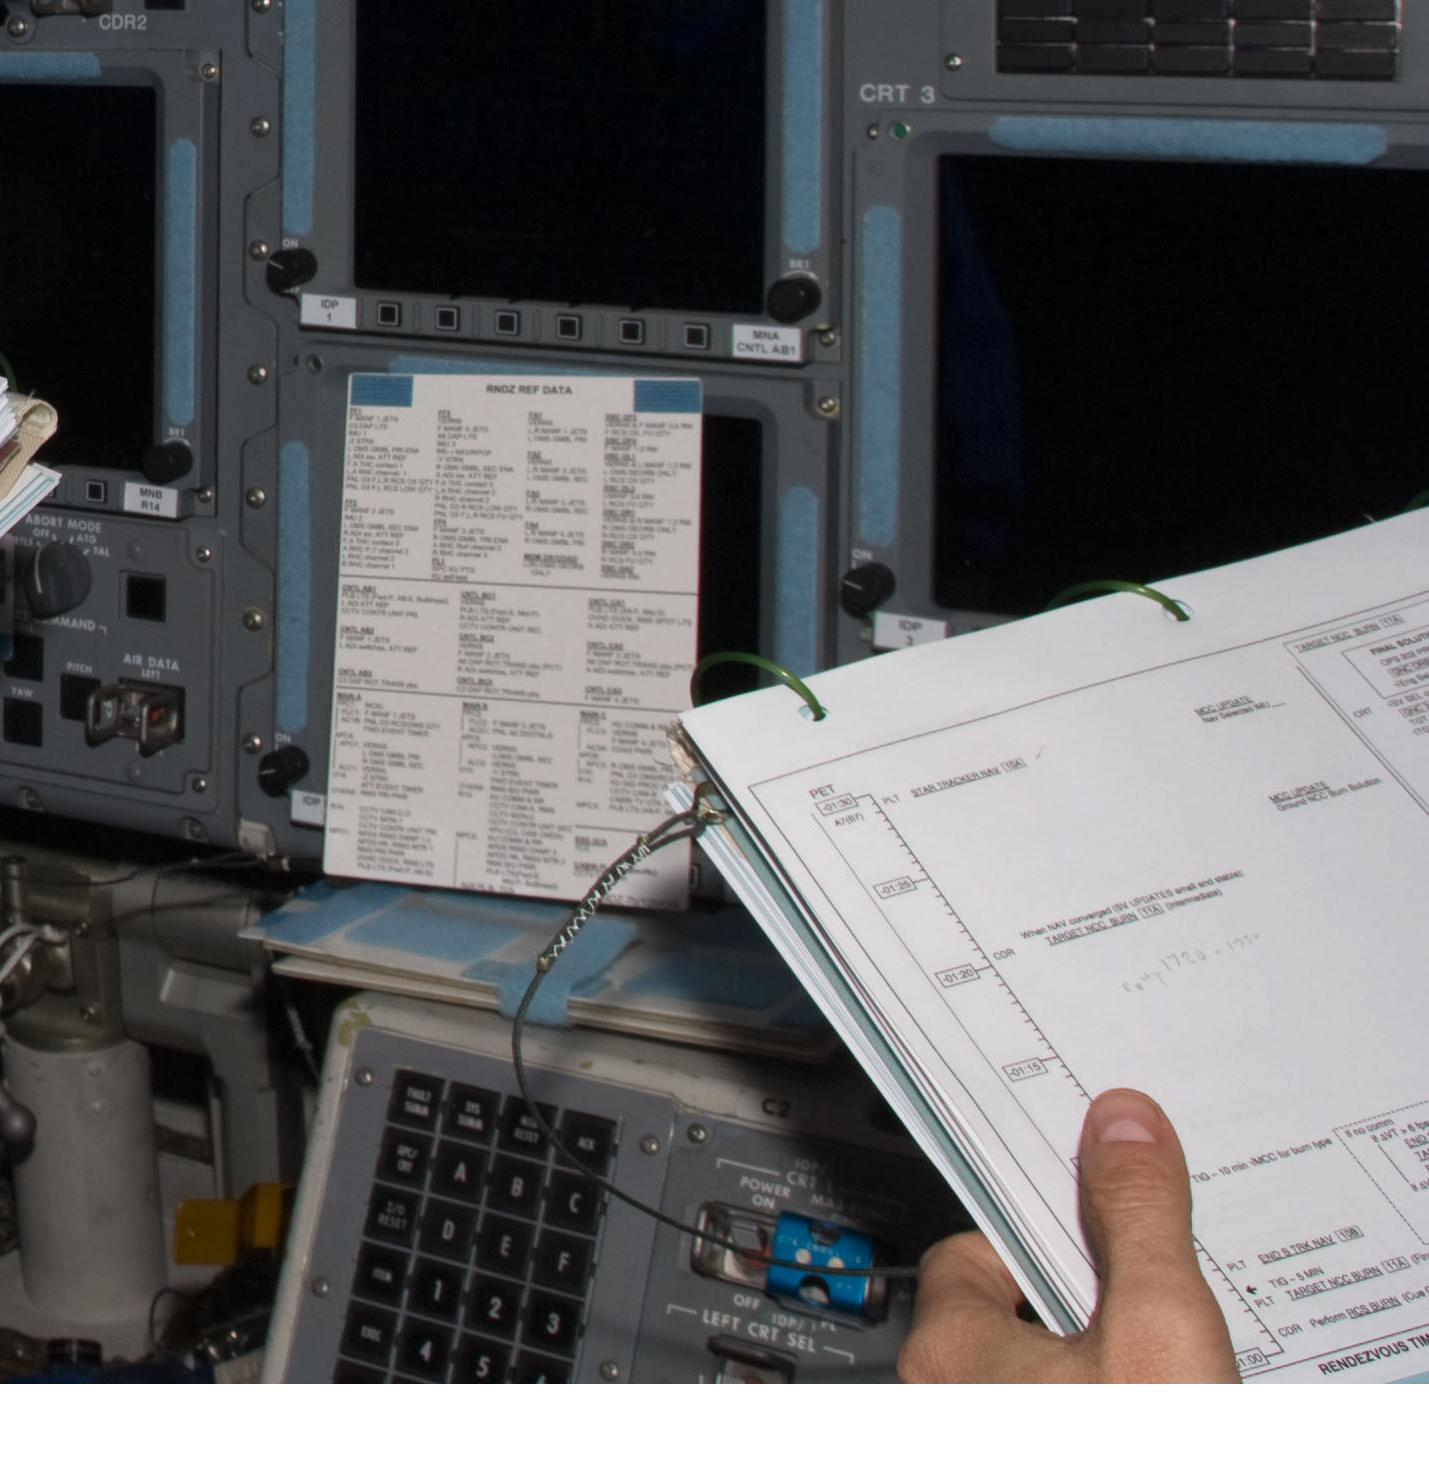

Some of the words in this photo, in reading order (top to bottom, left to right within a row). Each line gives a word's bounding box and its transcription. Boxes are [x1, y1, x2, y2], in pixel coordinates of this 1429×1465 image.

[99, 14, 147, 30] CDR2
[860, 84, 909, 103] CRT
[921, 85, 935, 104] 3
[321, 299, 339, 309] IDP
[753, 330, 779, 341] MNA
[737, 342, 768, 354] CNTL
[772, 344, 796, 356] AB1
[486, 384, 516, 394] RNDZ
[518, 385, 540, 395] REF
[543, 385, 573, 395] DATA
[139, 487, 163, 499] MNB
[141, 500, 161, 513] R14
[25, 513, 63, 529] ABORT
[67, 517, 102, 534] MODE
[67, 661, 92, 674] PITCH
[124, 653, 143, 667] AIR
[148, 655, 180, 672] DATA
[910, 783, 938, 798] STAR
[939, 770, 980, 789] TRACKER
[980, 764, 1001, 779] NAV
[809, 784, 836, 800] PET
[882, 794, 901, 805] PLT
[880, 880, 912, 895] -01:25
[1046, 920, 1068, 933] NAV
[1130, 888, 1175, 907] UPDATES
[1045, 924, 1085, 946] TARGET
[1084, 919, 1108, 937] NCC
[1110, 911, 1140, 929] BURN
[993, 947, 1017, 961] CDR
[942, 969, 975, 984] -01:20
[761, 1098, 791, 1118] C2
[454, 1161, 467, 1182] A
[510, 1176, 524, 1198] B
[740, 1175, 792, 1199] POWER
[569, 1192, 582, 1213] C
[752, 1193, 775, 1210] ON
[1227, 1259, 1248, 1273] PLT
[1284, 1279, 1329, 1301] TARGET
[1327, 1272, 1353, 1290] NCC
[1352, 1265, 1384, 1285] BURN
[733, 1293, 761, 1310] OFF
[1277, 1322, 1304, 1338] CDR
[1309, 1310, 1347, 1329] Perform
[1346, 1304, 1370, 1320] RCS
[1369, 1295, 1402, 1314] BURN
[702, 1308, 741, 1332] LEFT
[747, 1322, 780, 1343] CRT
[787, 1331, 817, 1353] SEL
[1317, 1340, 1411, 1376] RENDEZVOUS
